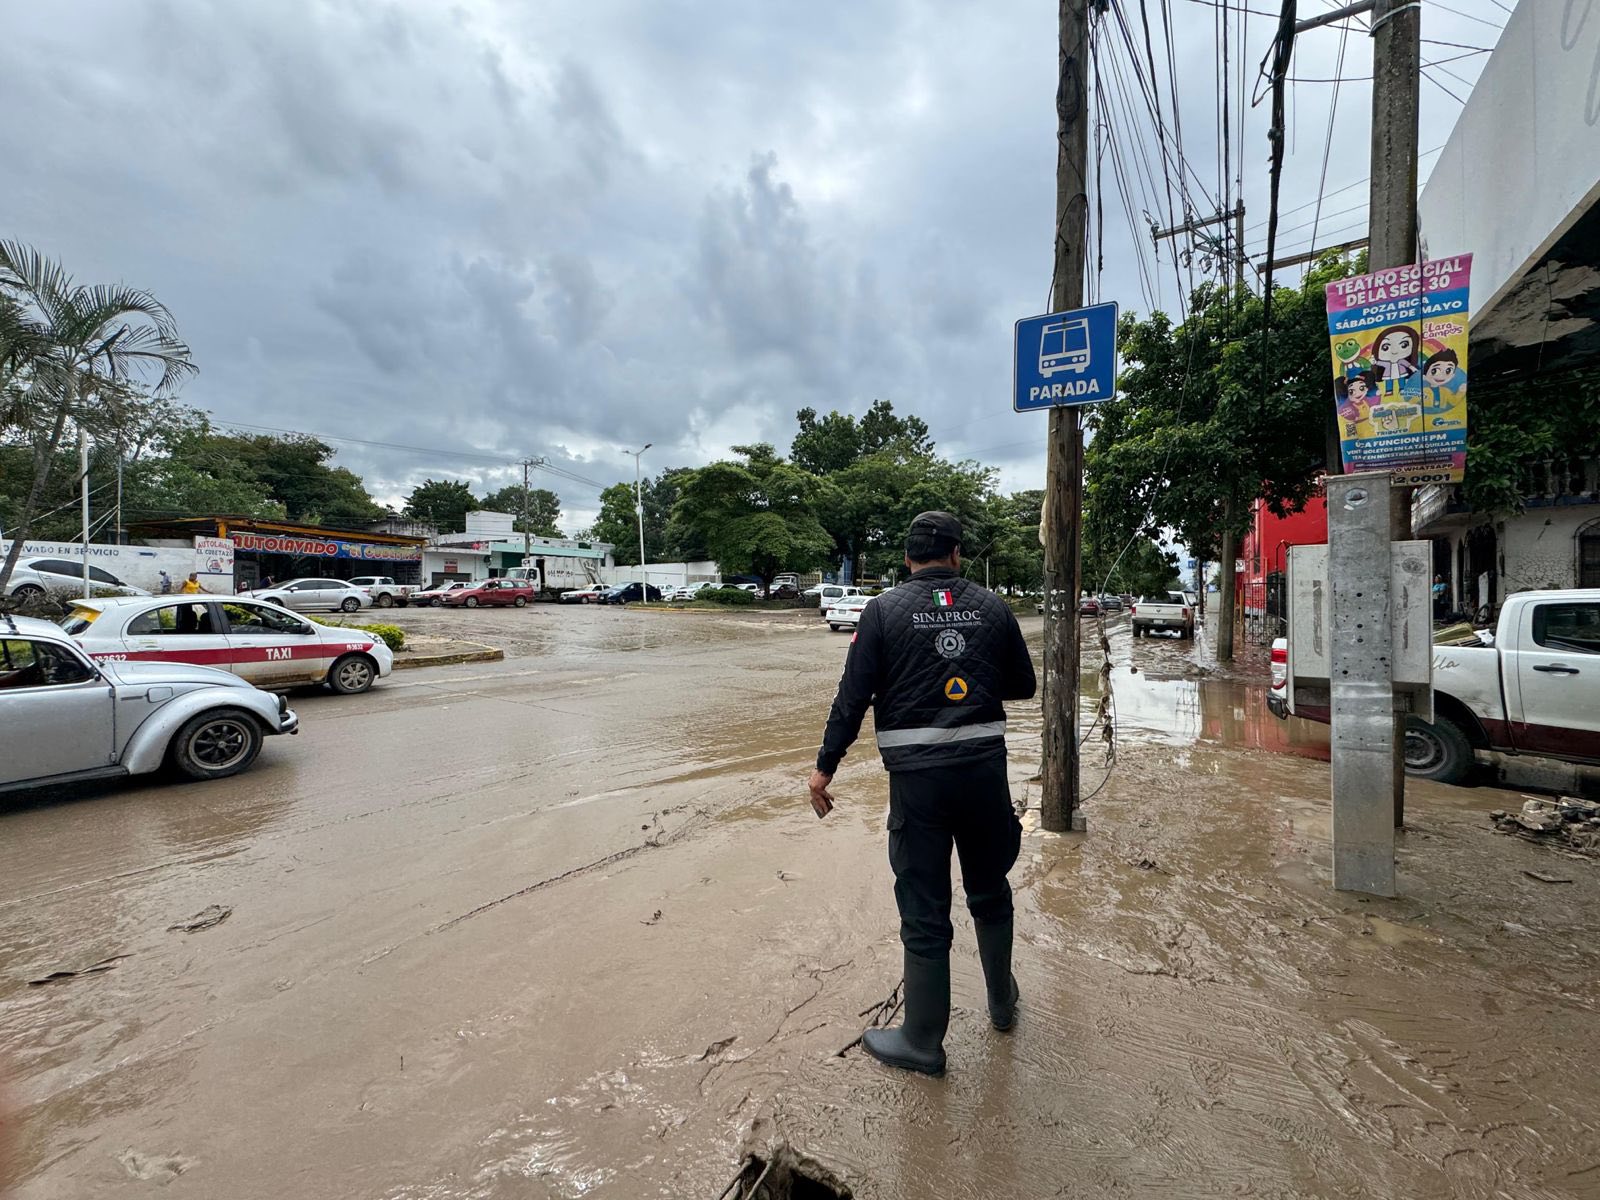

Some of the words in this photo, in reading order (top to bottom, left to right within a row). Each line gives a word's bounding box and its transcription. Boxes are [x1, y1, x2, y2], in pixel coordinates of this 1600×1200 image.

[1336, 271, 1397, 296] TEATRO
[1400, 258, 1463, 282] SOCIAL
[1346, 292, 1366, 308] DE
[1367, 287, 1388, 303] LA
[1389, 281, 1425, 298] SEC.
[1428, 274, 1451, 291] 30
[1362, 301, 1396, 316] POZA
[1397, 296, 1430, 309] RICA
[1335, 315, 1385, 330] SÁBADO
[1386, 311, 1398, 321] 17
[1399, 307, 1417, 318] DE
[1421, 300, 1463, 315] MAYO
[1422, 326, 1464, 339] Campos
[1428, 322, 1453, 333] Lara
[1029, 379, 1100, 401] PARADA
[1429, 433, 1448, 441] PM
[57, 547, 71, 555] EN
[74, 547, 120, 557] SERVICIO
[232, 534, 338, 556] AUTOLAVADO
[912, 610, 980, 623] SINAPROC
[265, 647, 292, 660] TAXI
